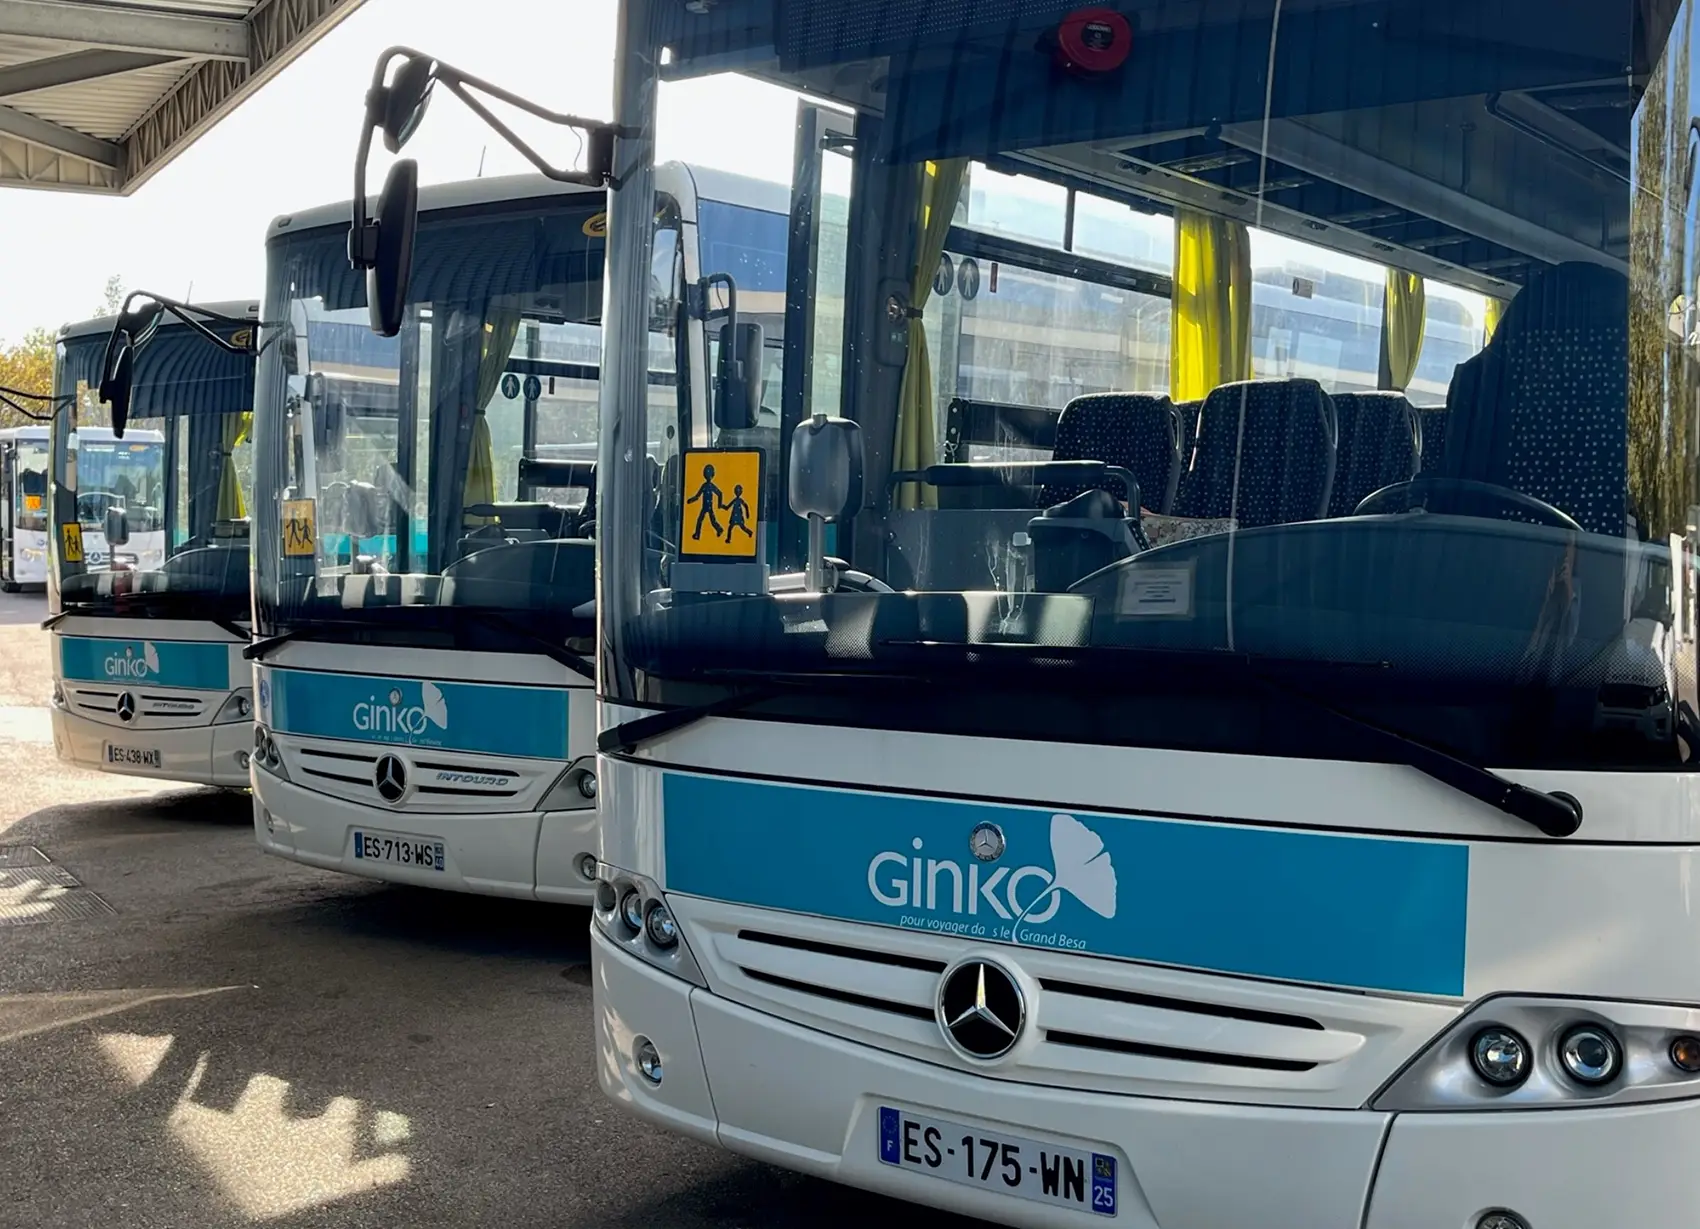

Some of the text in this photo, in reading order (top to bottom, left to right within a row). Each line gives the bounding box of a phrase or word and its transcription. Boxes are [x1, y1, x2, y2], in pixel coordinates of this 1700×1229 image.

[364, 836, 433, 866] ES-713-WS
[900, 915, 925, 927] pour
[926, 919, 970, 934] voyager
[1000, 925, 1010, 939] le
[1020, 928, 1057, 945] Grand
[887, 1139, 894, 1151] F
[904, 1120, 1085, 1202] ES-175-WN
[1094, 1185, 1114, 1207] 25
